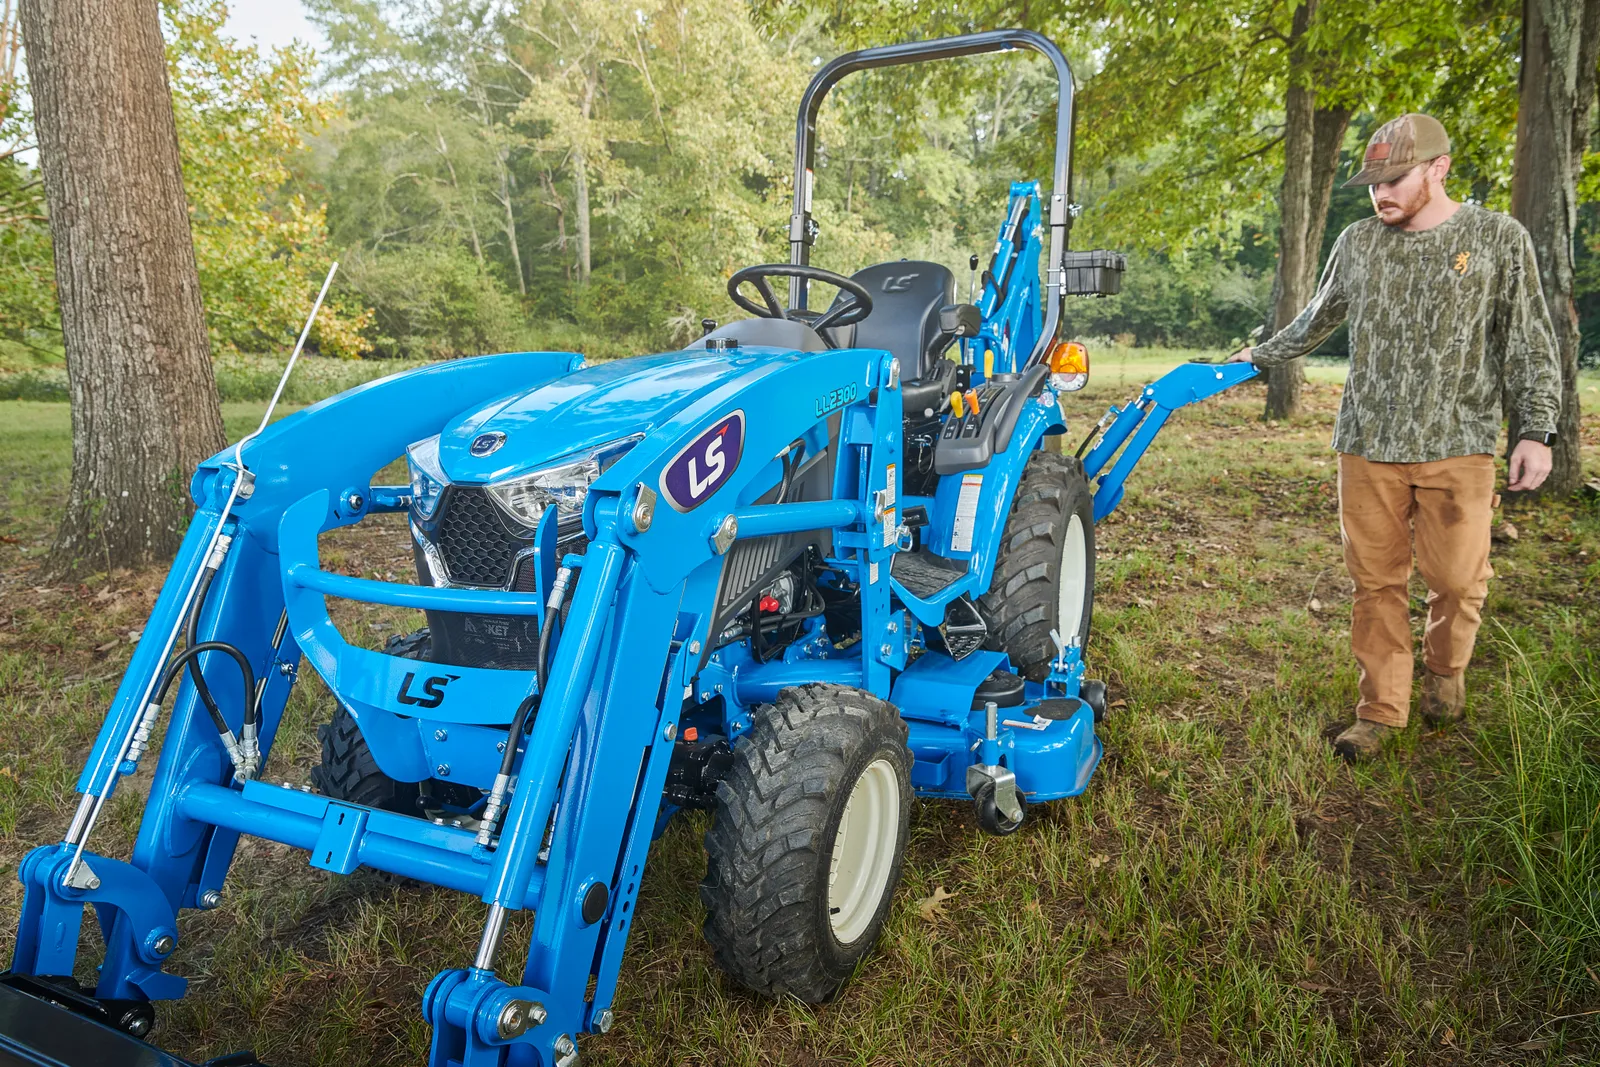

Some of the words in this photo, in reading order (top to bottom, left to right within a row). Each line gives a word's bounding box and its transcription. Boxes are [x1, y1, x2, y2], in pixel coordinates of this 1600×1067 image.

[881, 274, 914, 292] LS
[815, 382, 857, 418] LL2300
[688, 433, 726, 499] LS
[397, 671, 449, 709] LS
